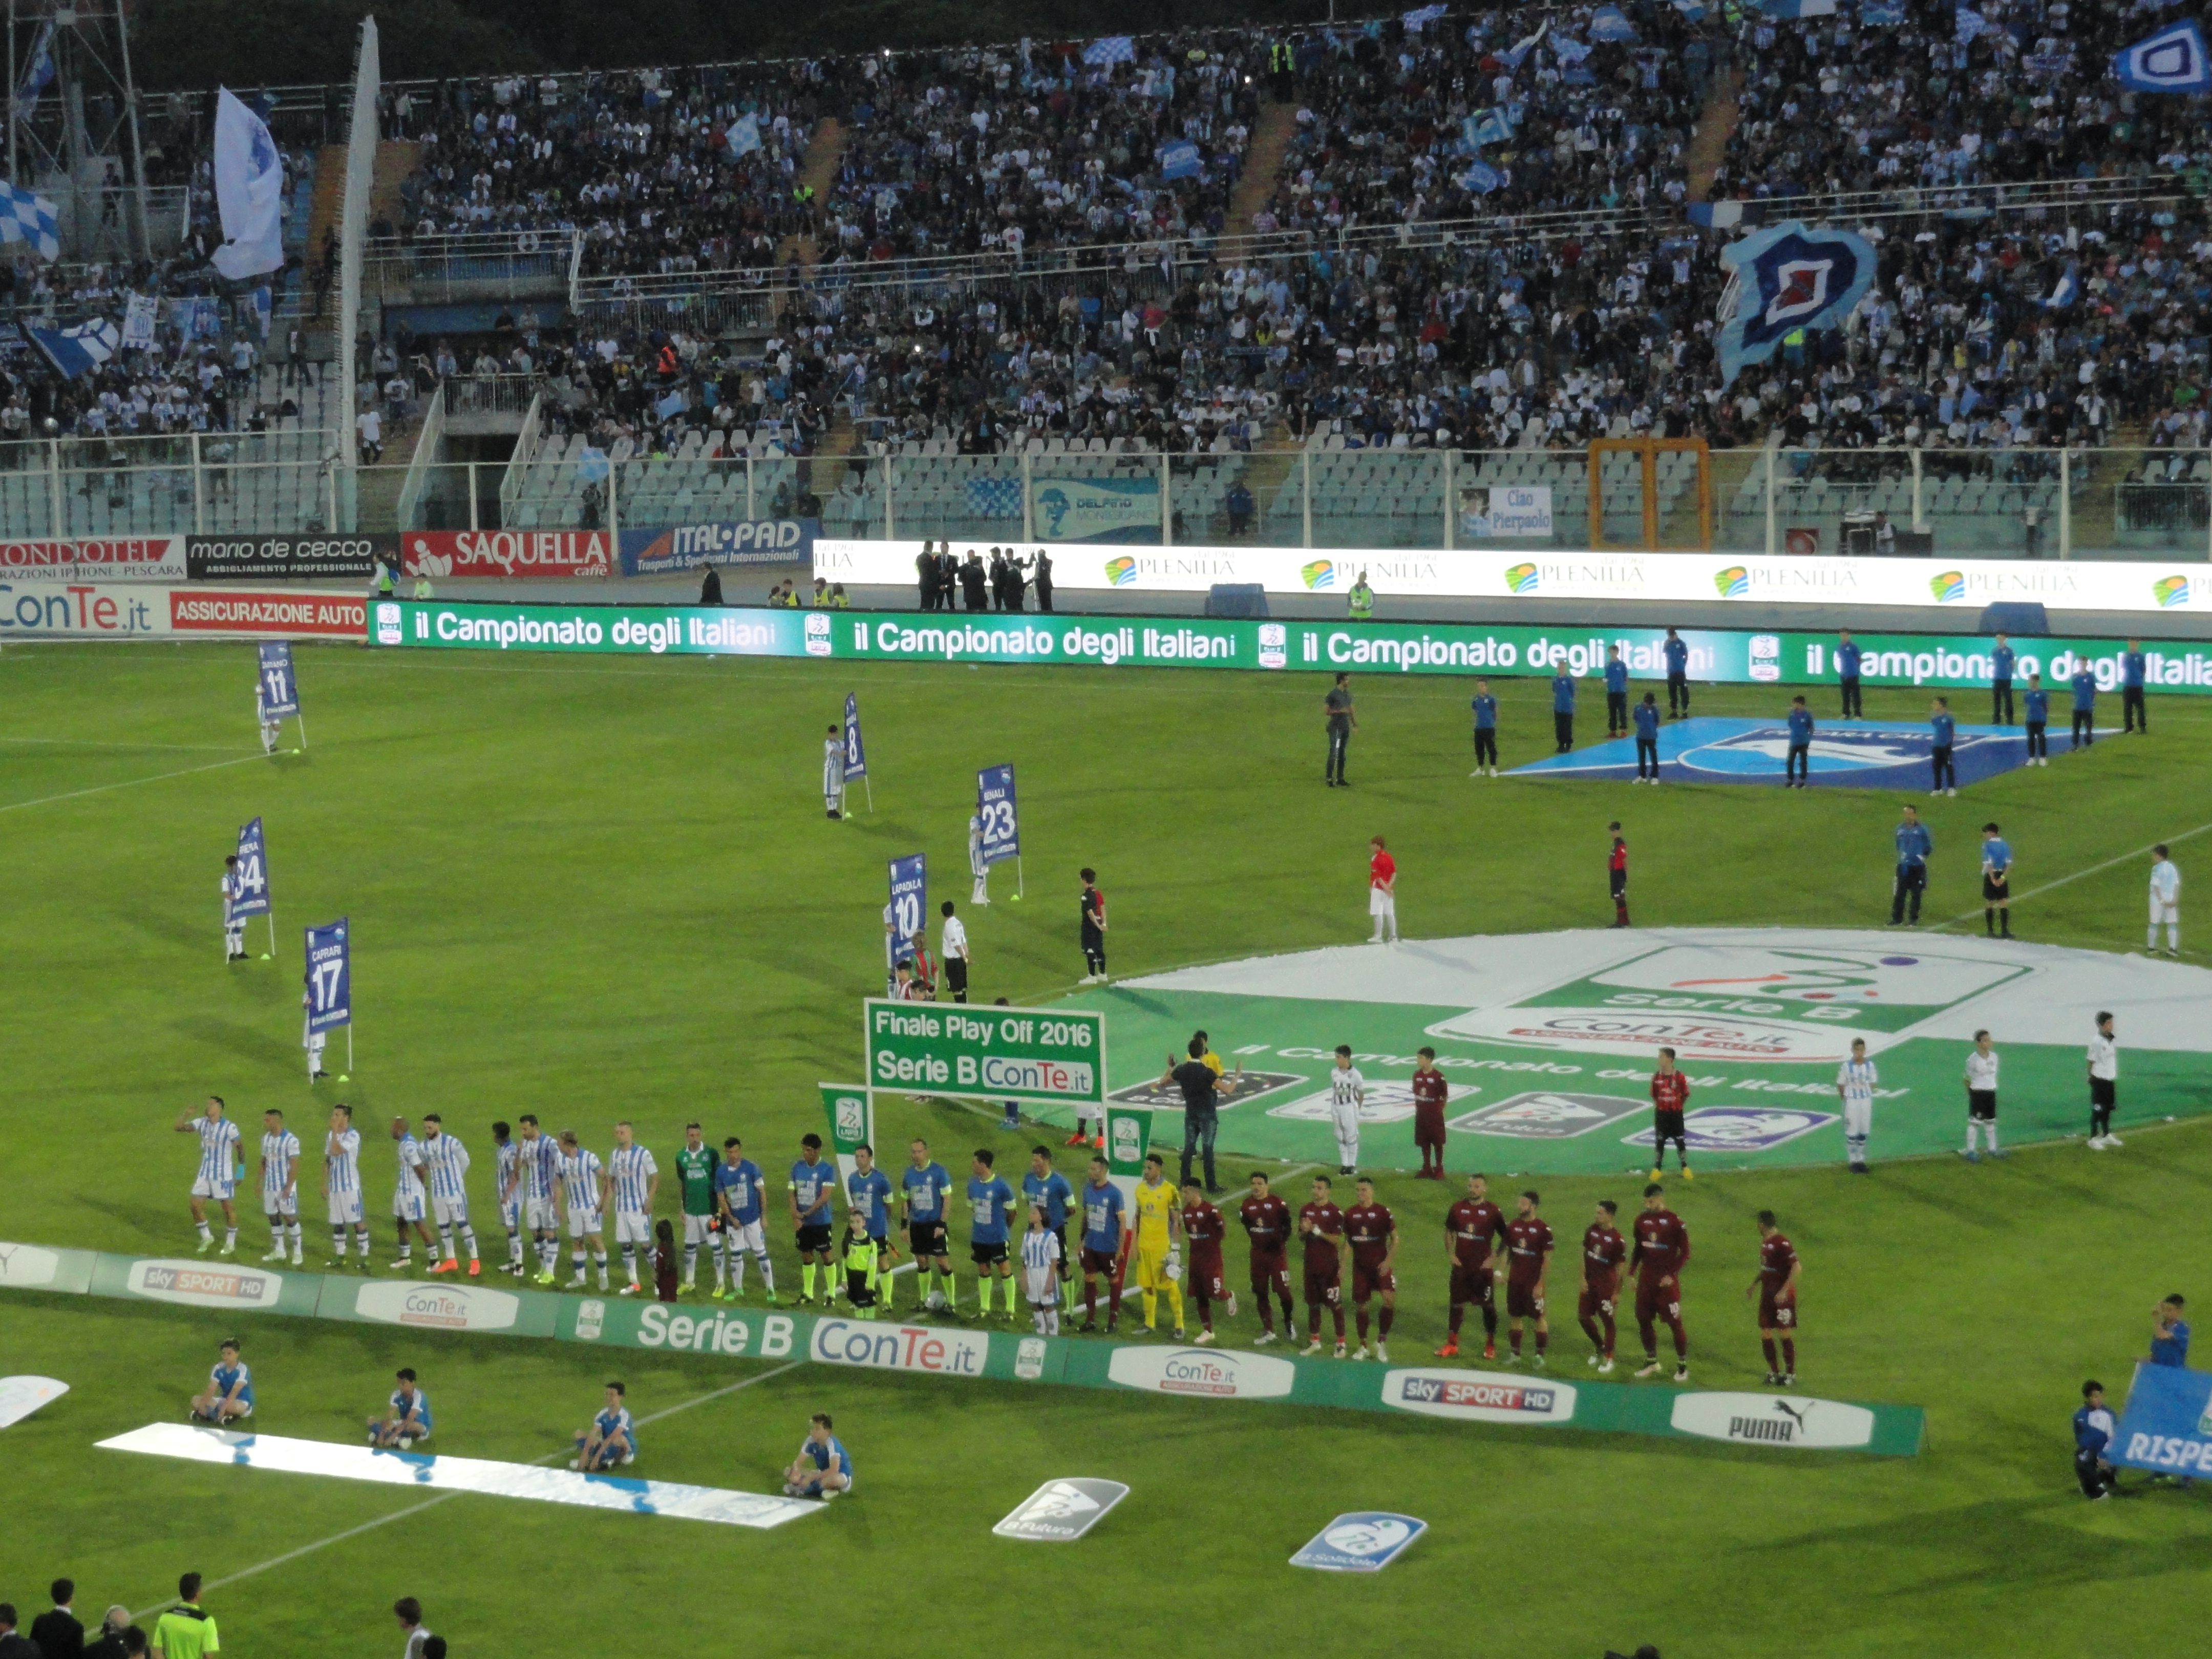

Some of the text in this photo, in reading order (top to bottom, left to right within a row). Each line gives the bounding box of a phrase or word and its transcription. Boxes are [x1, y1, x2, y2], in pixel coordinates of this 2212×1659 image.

[1493, 509, 1549, 534] Pierpaolo
[191, 539, 372, 559] mario de cecco
[457, 533, 608, 575] SAQUELLA
[638, 556, 674, 572] Trasporti
[676, 556, 684, 567] &
[730, 549, 799, 563] Internazionali
[124, 565, 184, 577] PESCARA
[206, 563, 372, 573] ABBIGLIAMENTO PROFESSIONALE
[574, 563, 608, 577] caffè
[1140, 558, 1235, 576] PLENILIA
[1337, 562, 1438, 579] PLENILIA
[1542, 565, 1645, 582] PLENILIA
[1752, 568, 1858, 586] PLENILIA
[1969, 573, 2078, 591] PLENILIA
[177, 600, 365, 626] ASSICURAZIONE AUTO
[416, 611, 776, 653] il Campionato degli Italiani
[855, 622, 1235, 665] il Campionato degli Italiani
[1303, 632, 1317, 662] il
[1328, 632, 1517, 671] Campionato
[1536, 637, 1604, 677] degli
[1806, 644, 1823, 674] il
[267, 670, 288, 704] 11
[848, 726, 858, 764] 8
[982, 800, 1016, 845] 23
[233, 855, 265, 900] 34
[895, 892, 919, 941] 10
[312, 959, 344, 1012] 17
[1602, 993, 1862, 1019] Serie B
[876, 1011, 1092, 1048] Finale Play Off 2016
[877, 1050, 1089, 1092] Serie B ConTe.it
[146, 1267, 263, 1296] sky SPORT HD
[406, 1293, 466, 1316] ConTe.it
[636, 1304, 976, 1373] Serie B ConTe.it
[1165, 1360, 1236, 1383] ConTe.it
[1406, 1379, 1550, 1409] sky SPORT HD
[1728, 1415, 1794, 1442] PUMA
